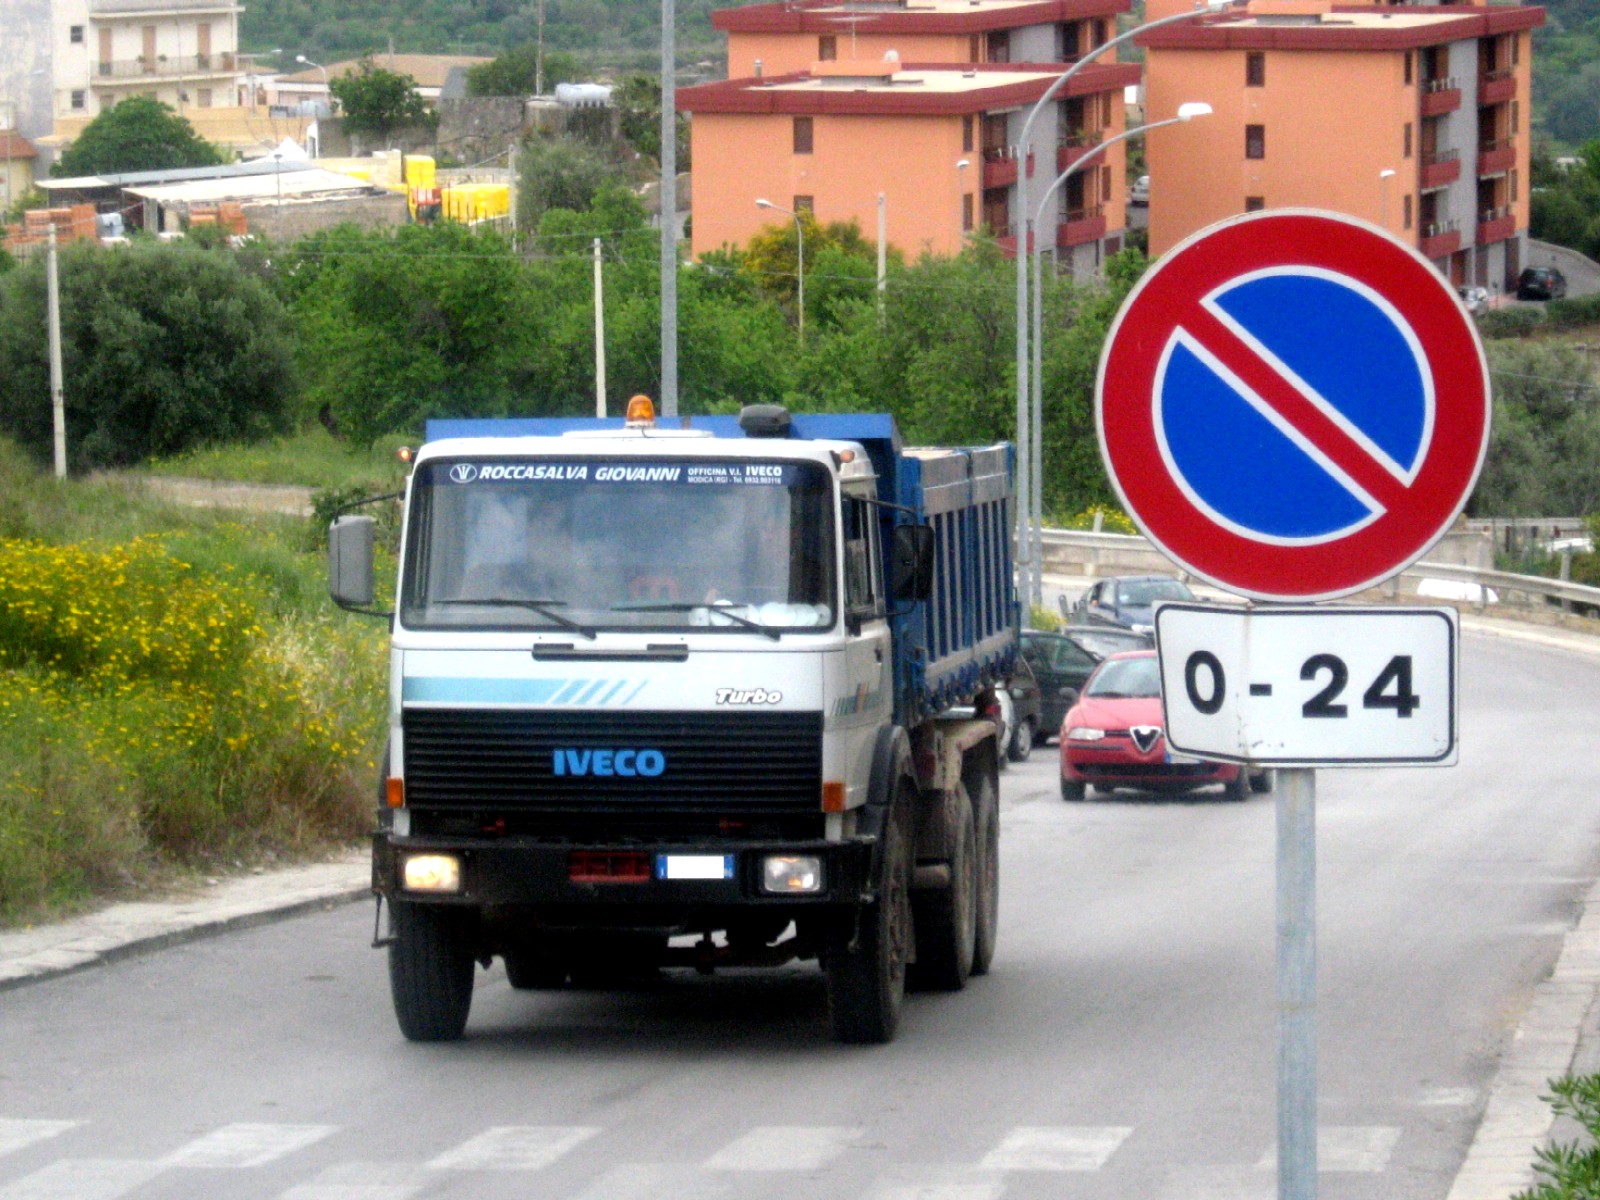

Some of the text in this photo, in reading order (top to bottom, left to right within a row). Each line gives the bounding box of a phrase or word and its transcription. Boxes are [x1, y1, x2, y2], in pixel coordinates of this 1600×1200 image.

[479, 465, 681, 481] ROCCASALVA GIOVANNI
[687, 467, 727, 476] OFFICINA
[745, 465, 783, 477] IVECO
[1184, 650, 1421, 719] 0 - 24
[715, 687, 783, 705] Turbo
[553, 749, 665, 777] IVECO
